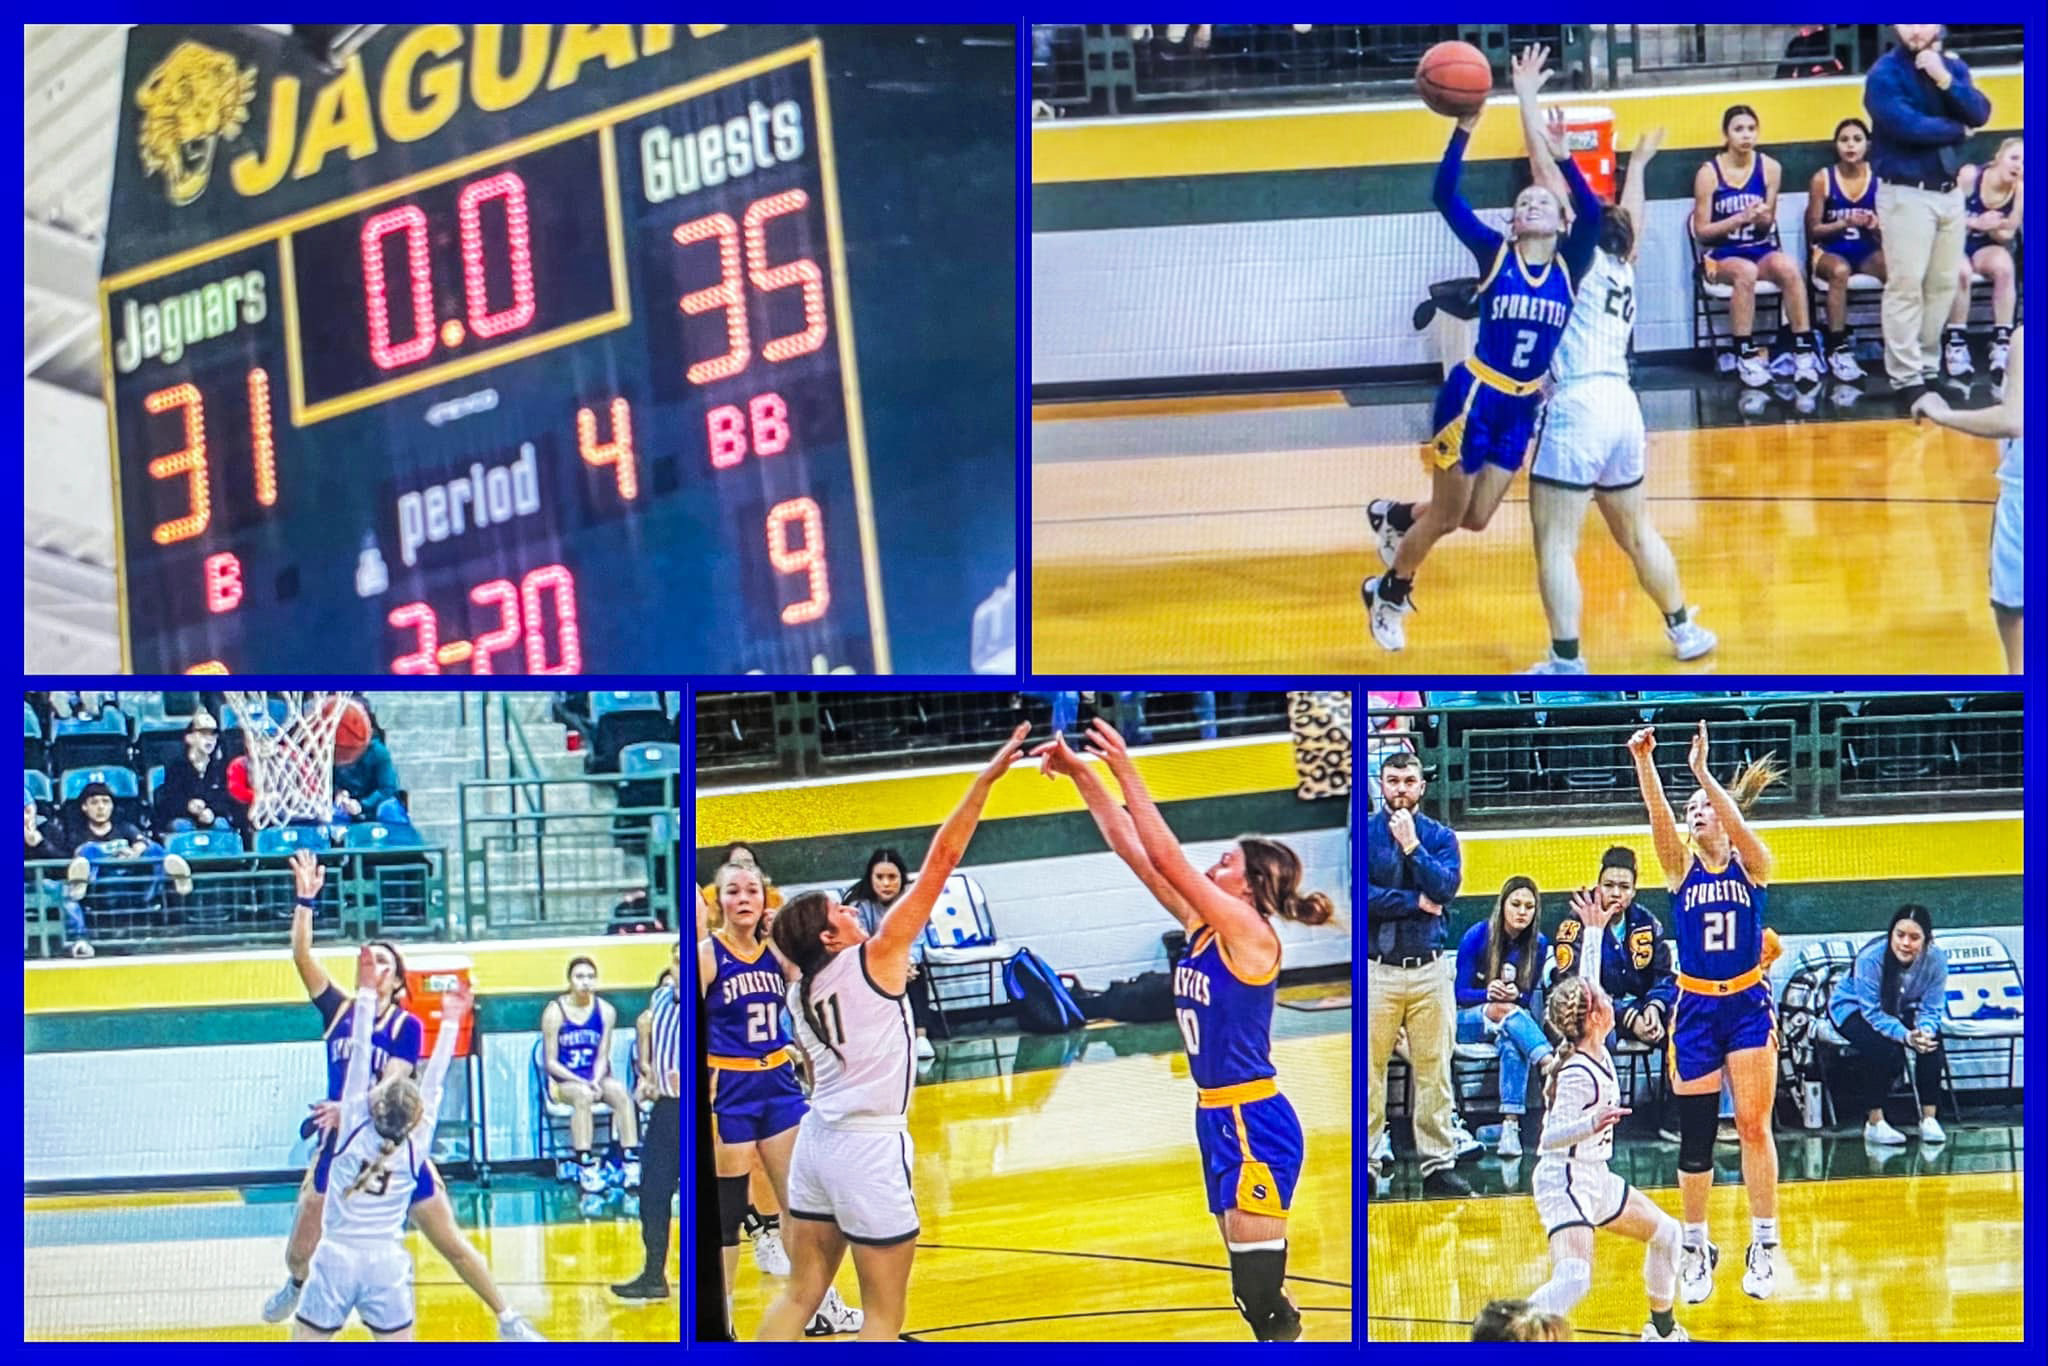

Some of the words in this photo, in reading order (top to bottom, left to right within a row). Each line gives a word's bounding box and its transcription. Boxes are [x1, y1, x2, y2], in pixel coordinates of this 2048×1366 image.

[641, 101, 804, 203] Guests
[360, 171, 535, 370] 0.0
[673, 188, 827, 385] 35
[116, 270, 267, 373] Jaguars
[1511, 329, 1538, 368] 2
[145, 367, 277, 545] 31
[577, 397, 638, 501] 4
[706, 393, 790, 470] BB
[399, 442, 541, 566] period
[205, 551, 244, 614] B
[766, 497, 831, 626] 9
[1684, 879, 1752, 912] SPURETTES
[1704, 910, 1737, 952] 21
[1629, 925, 1654, 970] S
[747, 1001, 777, 1043] 21
[1251, 1183, 1267, 1200] S
